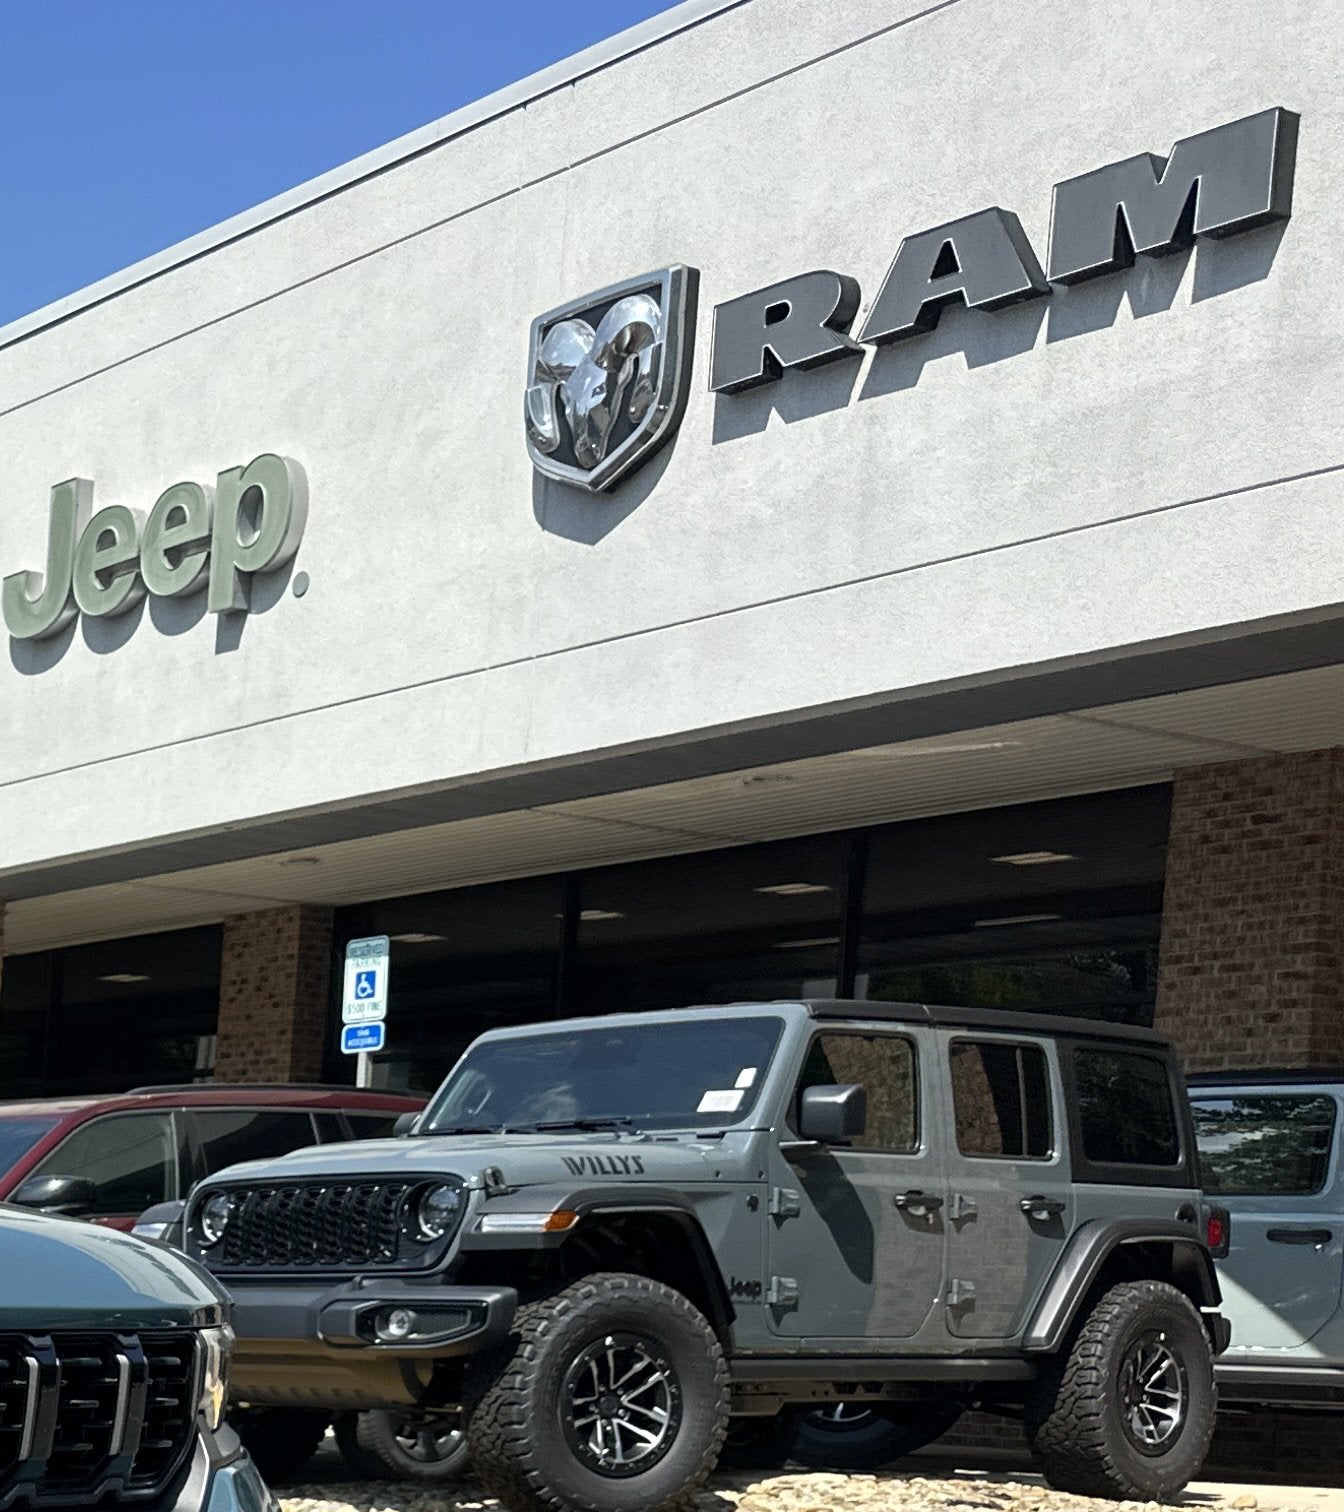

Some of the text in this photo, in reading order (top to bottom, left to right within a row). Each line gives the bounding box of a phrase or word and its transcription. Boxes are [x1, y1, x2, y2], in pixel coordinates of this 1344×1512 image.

[709, 107, 1302, 393] RAM
[560, 1154, 645, 1176] WILLYS
[729, 1276, 762, 1299] Jeep
